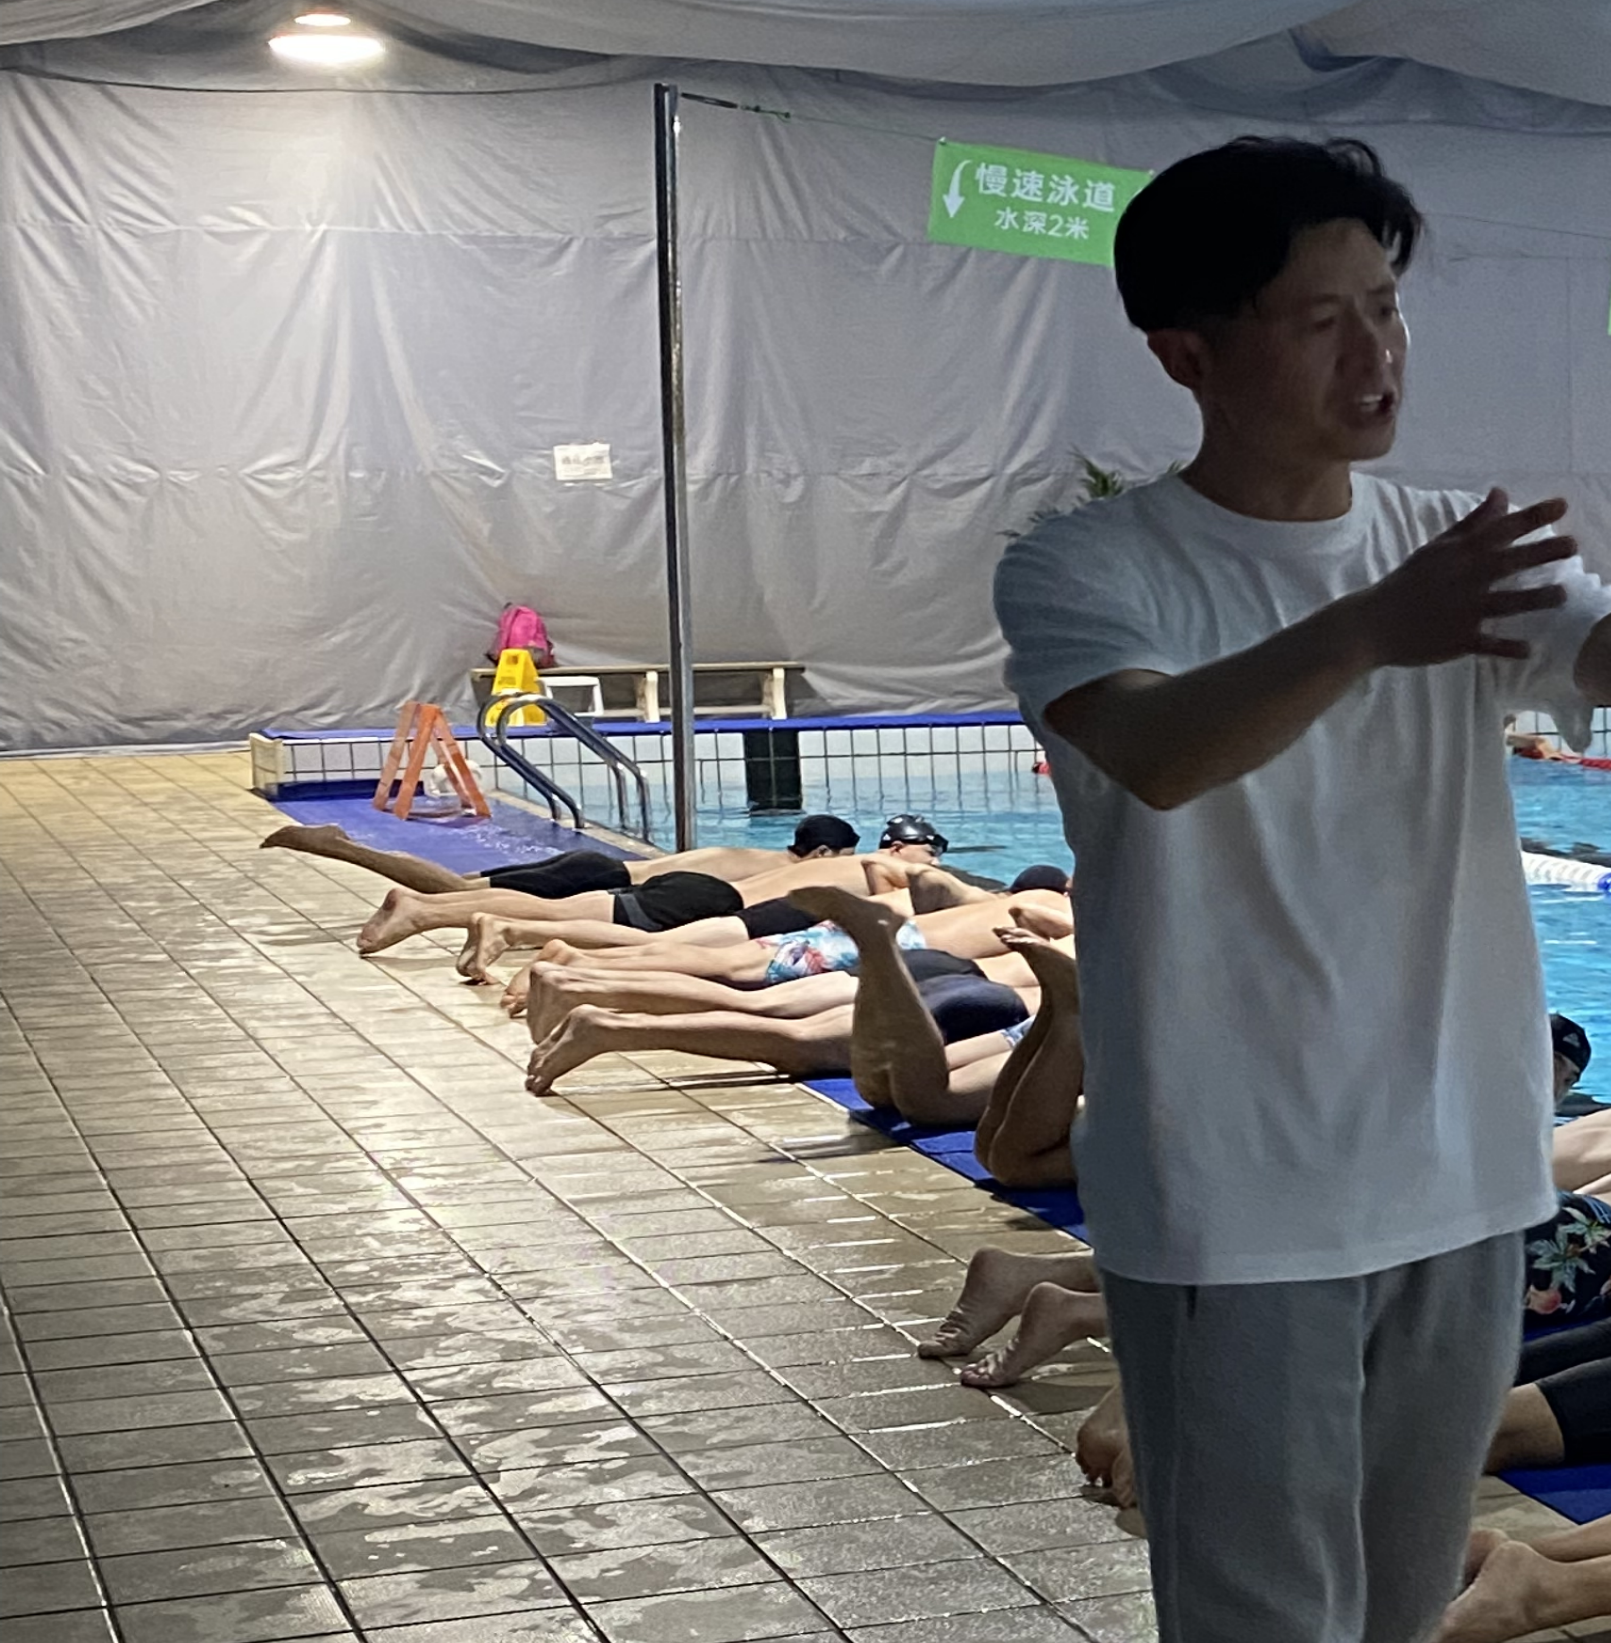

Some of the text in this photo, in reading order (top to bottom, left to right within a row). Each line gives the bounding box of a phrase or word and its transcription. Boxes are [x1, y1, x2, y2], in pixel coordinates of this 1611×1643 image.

[975, 162, 1115, 212] 慢速泳道
[994, 206, 1090, 239] 水深2米
